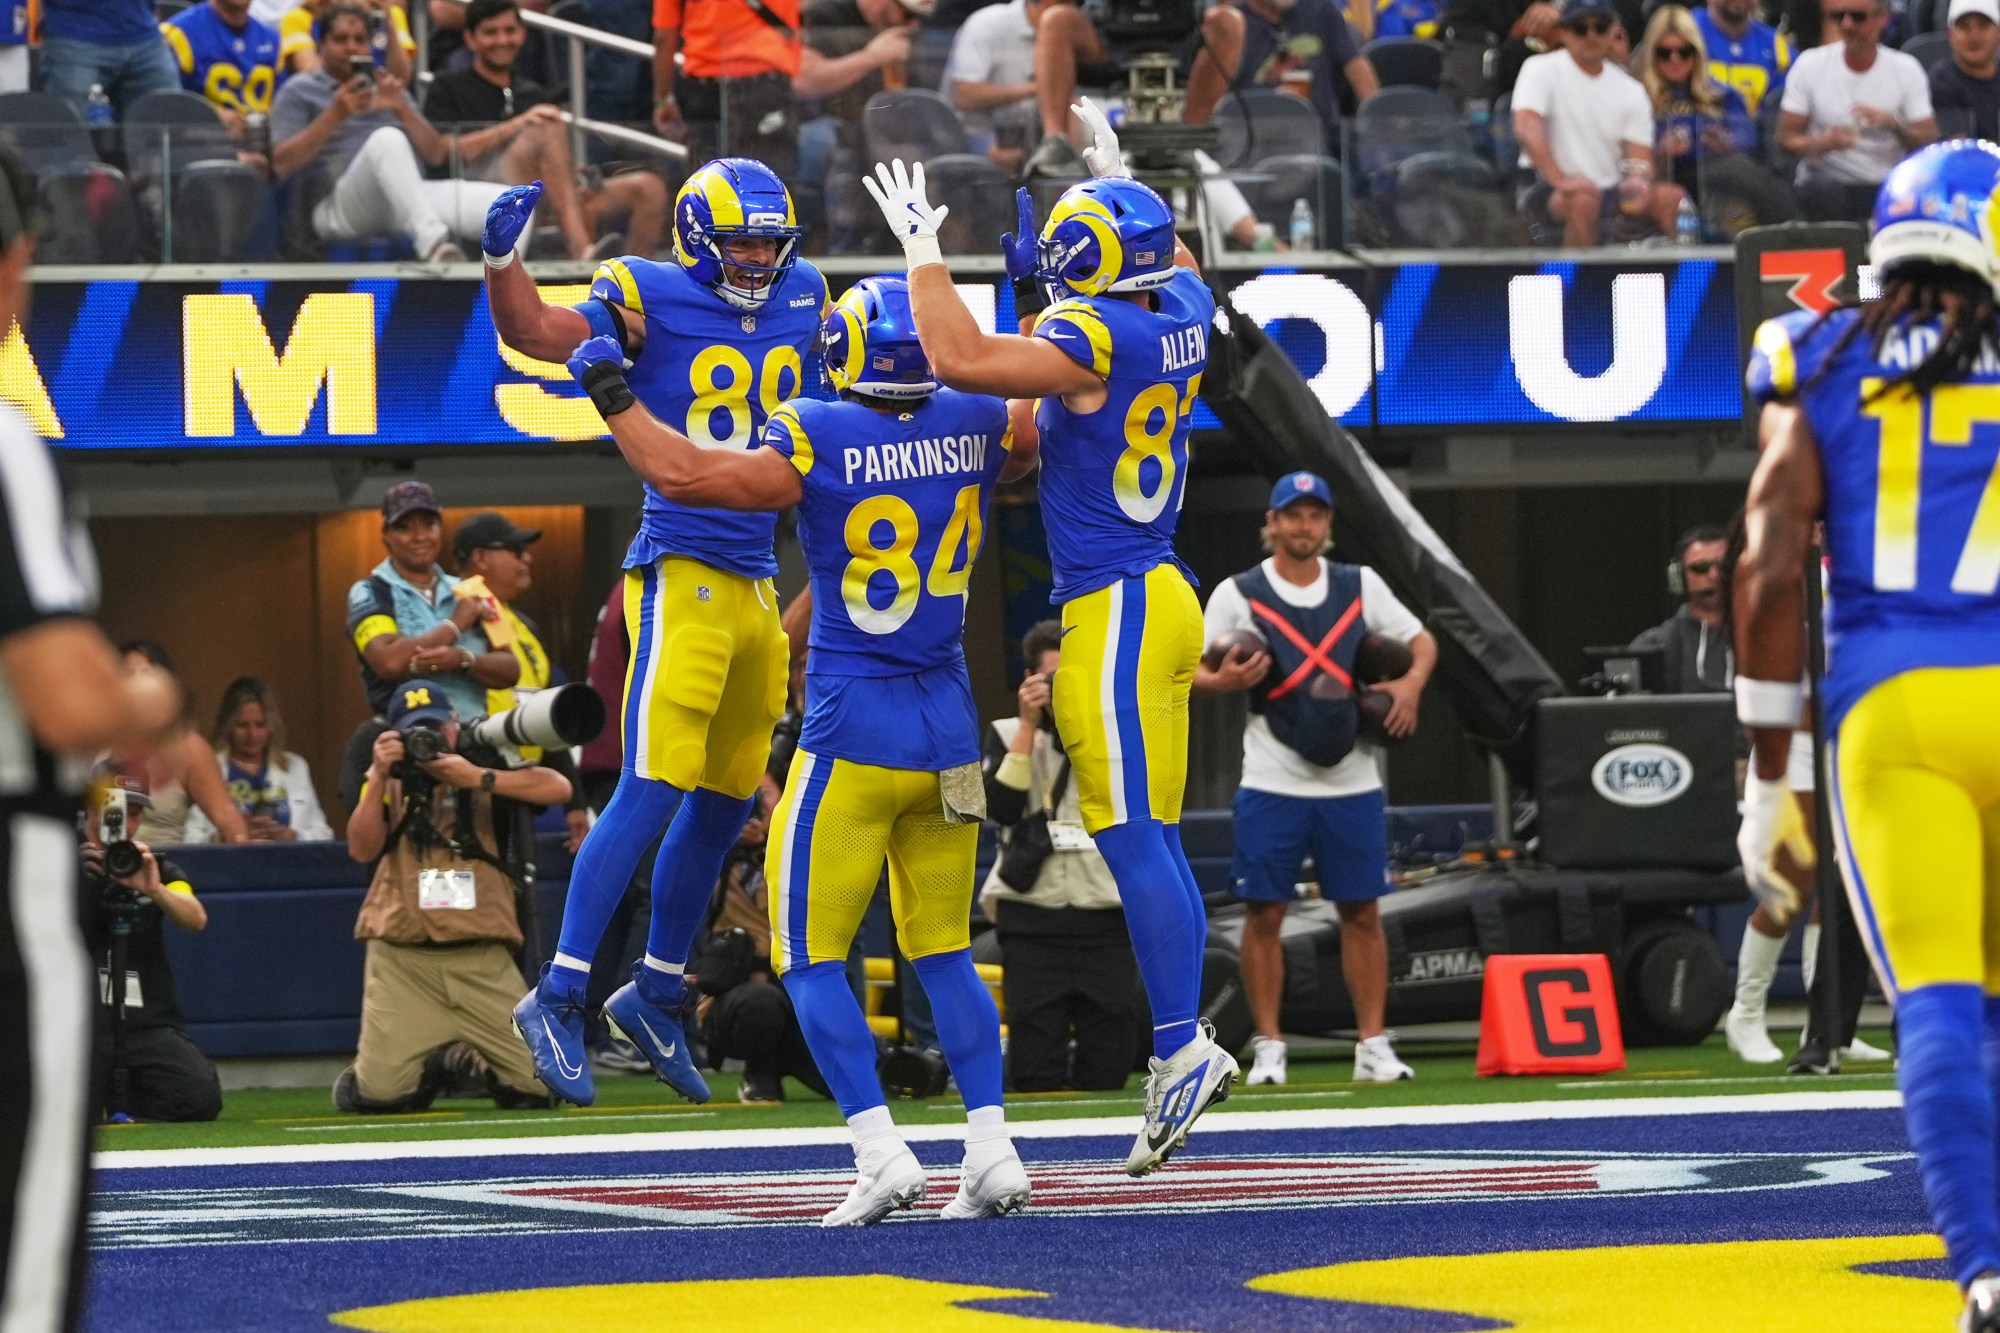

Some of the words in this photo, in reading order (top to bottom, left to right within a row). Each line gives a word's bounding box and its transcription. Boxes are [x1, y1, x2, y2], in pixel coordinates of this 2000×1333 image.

[1135, 279, 1156, 288] LOS
[789, 297, 816, 308] RAMS
[1161, 324, 1206, 374] ALLEN
[872, 387, 895, 396] LOS
[843, 434, 987, 485] PARKINSON
[1859, 376, 2000, 595] 17
[841, 483, 983, 635] 84
[404, 688, 431, 709] M
[1620, 761, 1665, 780] FOX
[1522, 968, 1602, 1058] G
[1178, 1086, 1194, 1116] ALPHA
